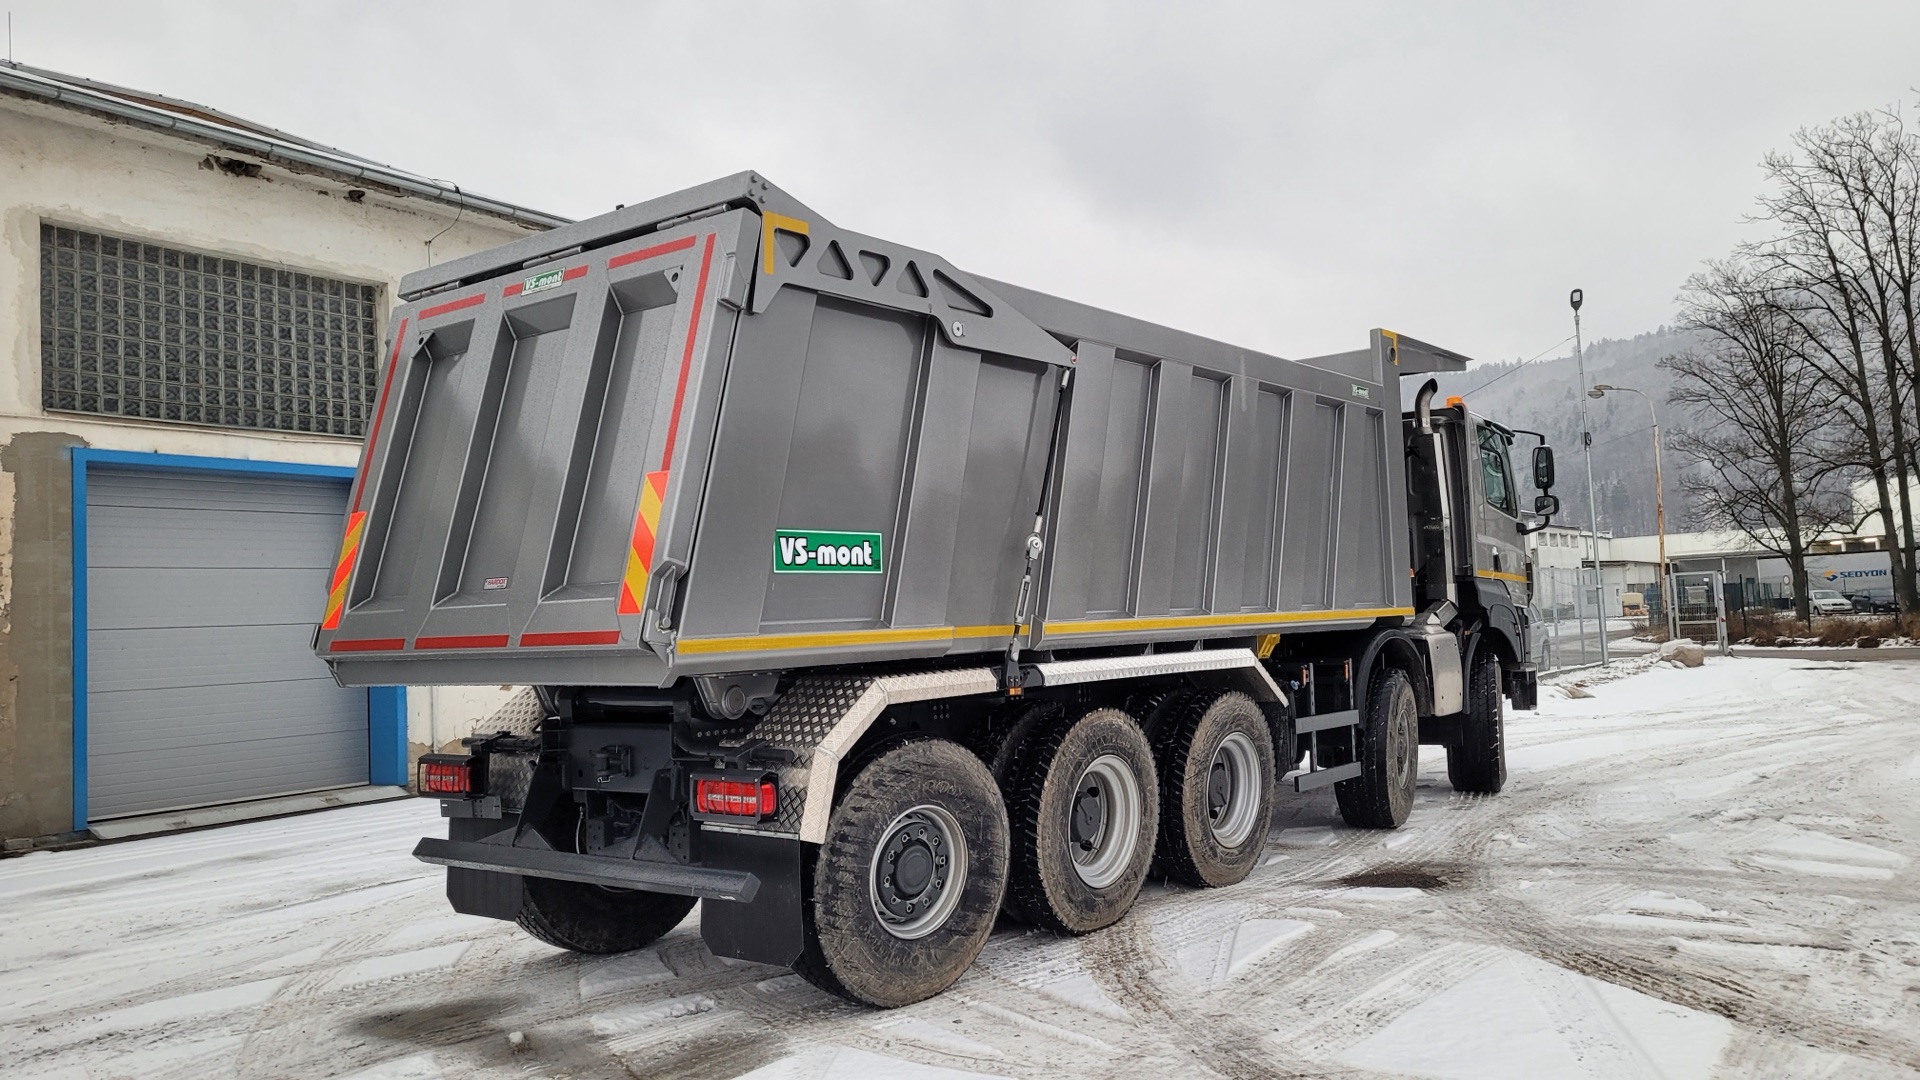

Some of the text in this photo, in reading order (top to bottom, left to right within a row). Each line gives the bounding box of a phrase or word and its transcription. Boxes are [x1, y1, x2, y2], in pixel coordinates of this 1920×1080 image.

[525, 270, 562, 290] VS-mont
[779, 537, 872, 566] VS-mont
[1839, 569, 1887, 578] SEOYON
